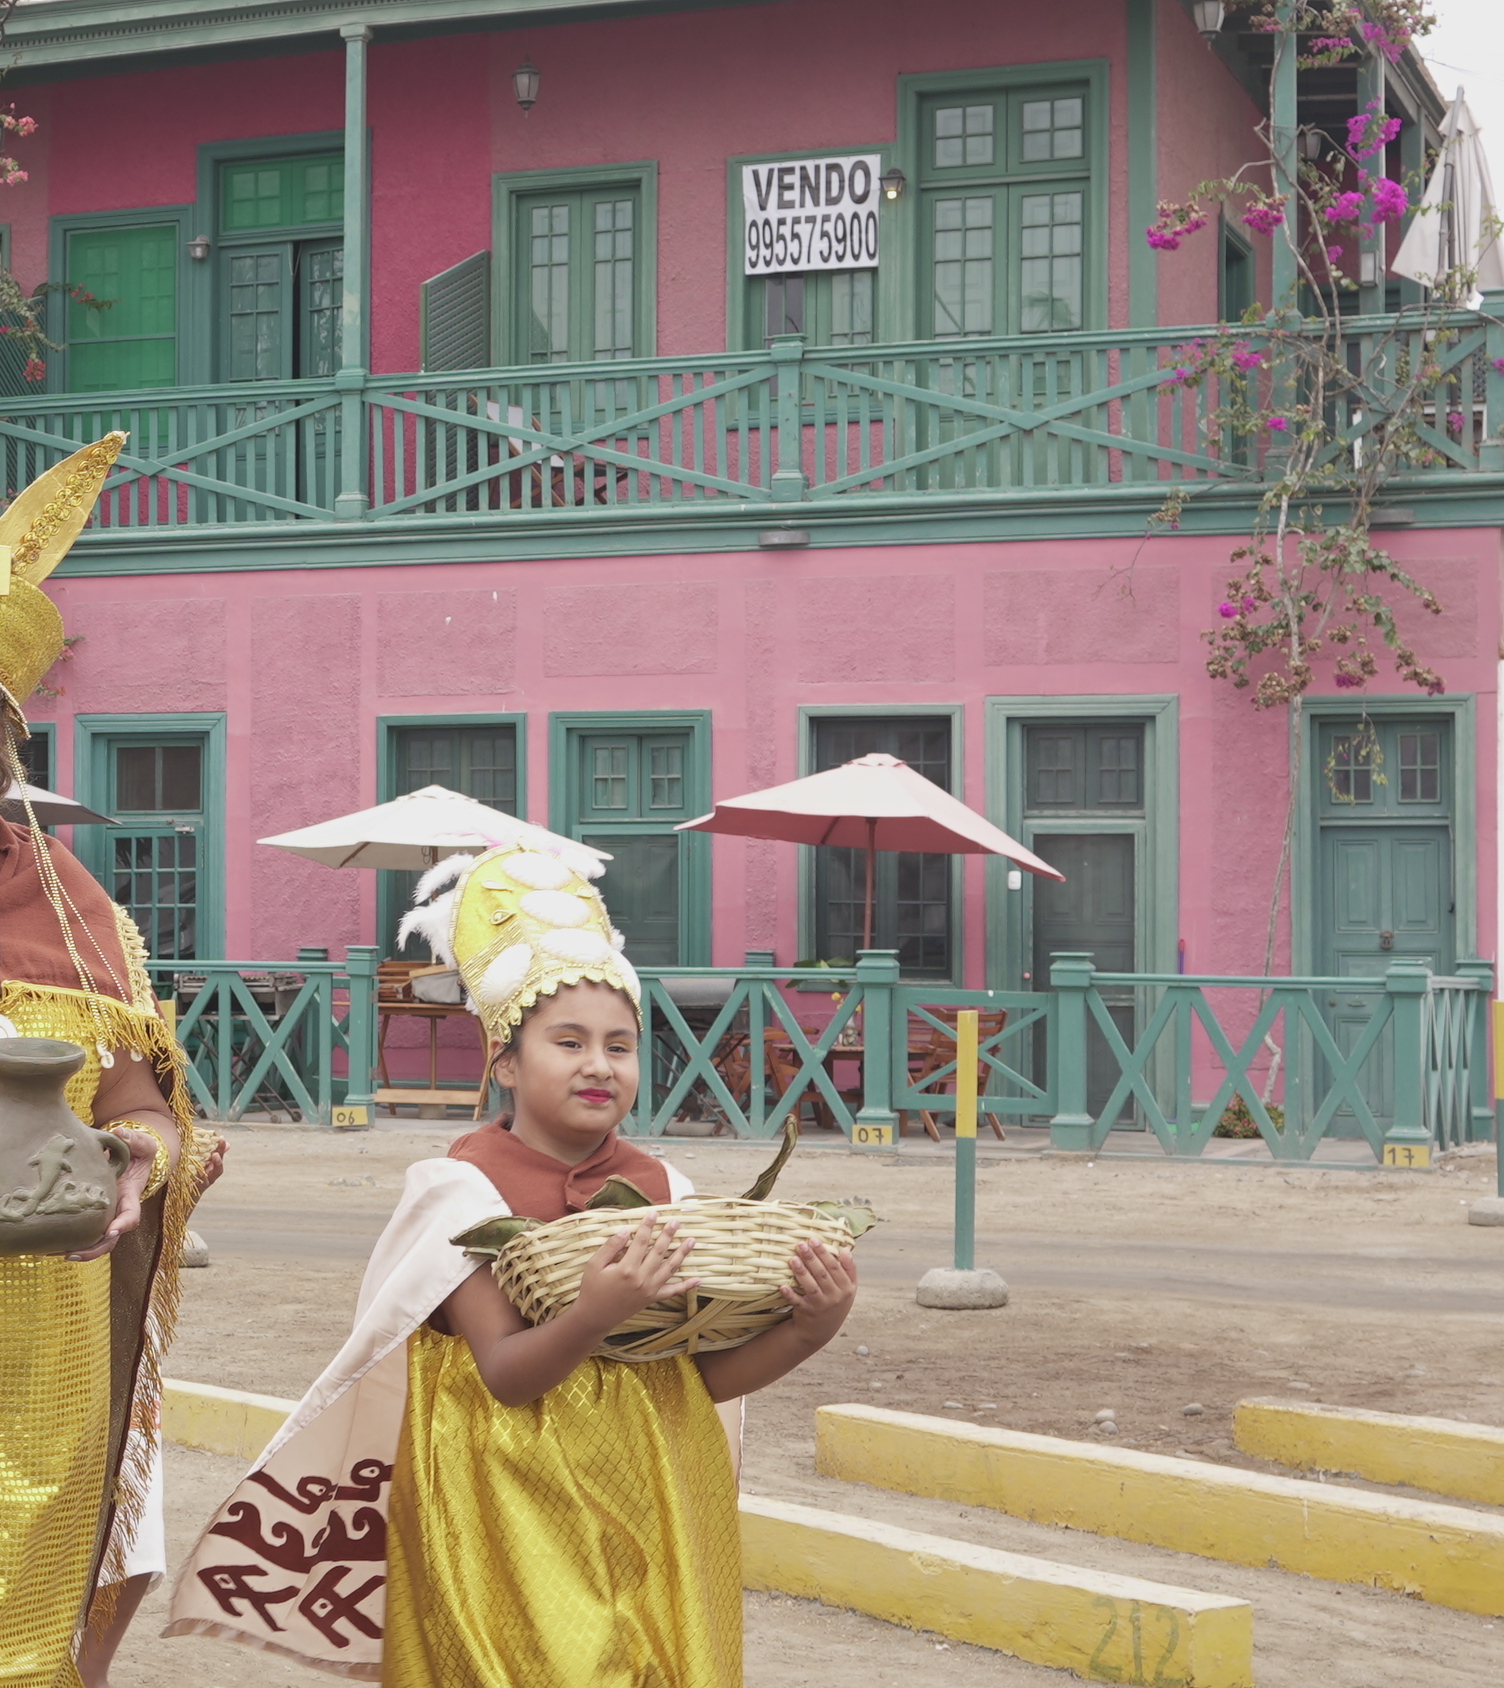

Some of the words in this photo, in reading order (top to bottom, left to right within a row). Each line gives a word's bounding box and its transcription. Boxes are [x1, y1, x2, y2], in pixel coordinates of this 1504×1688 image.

[752, 160, 872, 211] VENDO
[748, 210, 878, 269] 995575900
[336, 1111, 355, 1125] 06
[858, 1127, 884, 1145] 07
[1387, 1146, 1414, 1167] 17
[1088, 1595, 1185, 1688] 212
